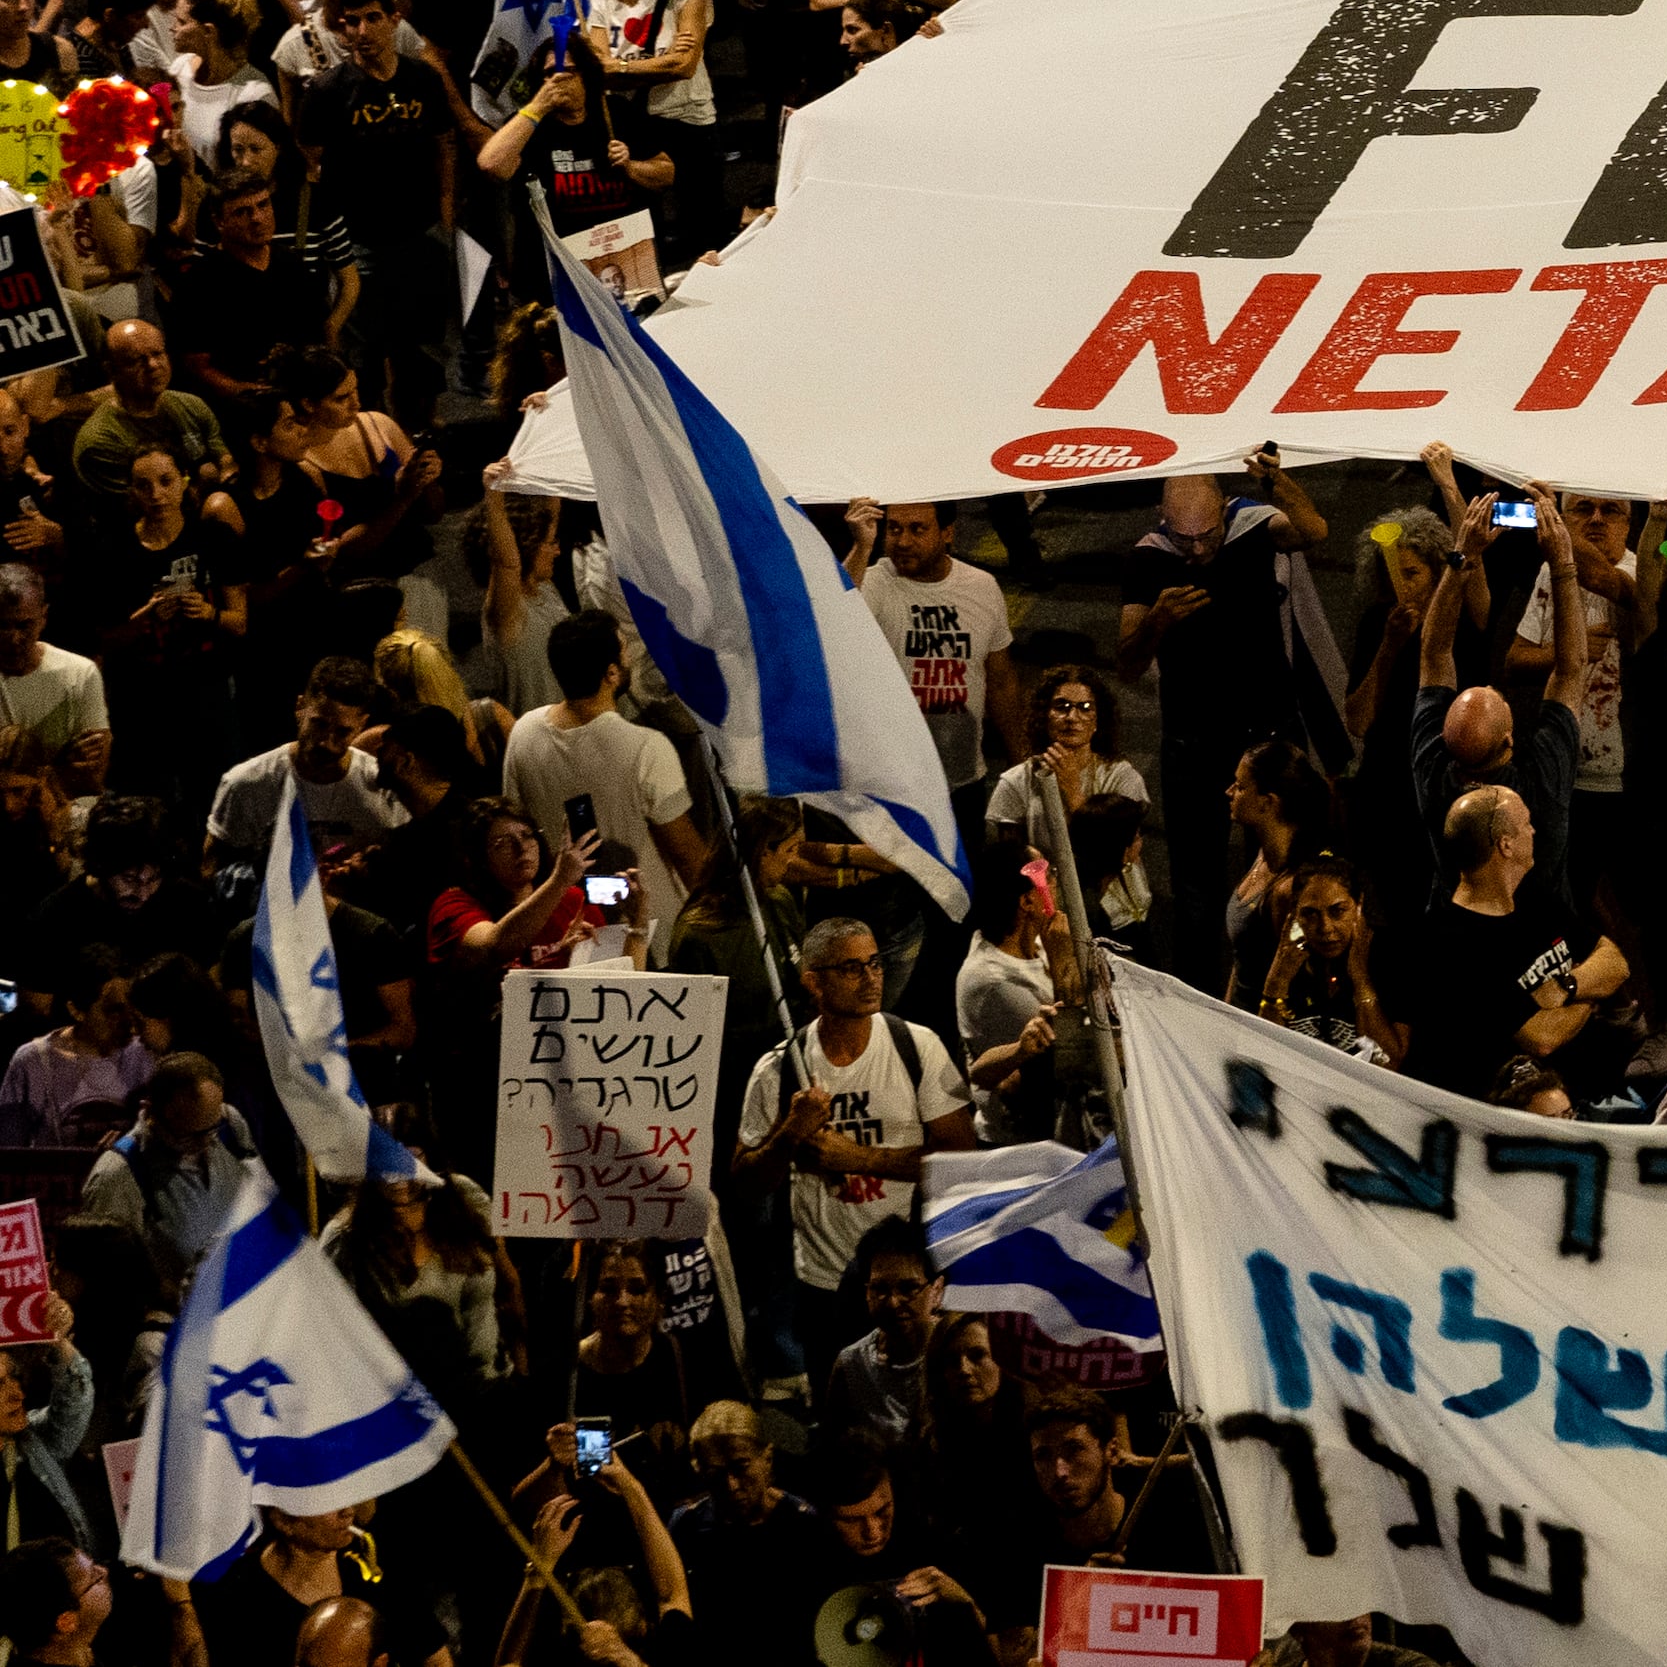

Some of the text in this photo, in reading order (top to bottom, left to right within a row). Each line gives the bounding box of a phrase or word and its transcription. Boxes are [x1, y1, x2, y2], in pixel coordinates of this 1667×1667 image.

[905, 631, 971, 660] הראש
[914, 659, 968, 688] אתה
[528, 982, 690, 1025] אתם
[529, 1023, 703, 1068] עושים
[501, 1074, 698, 1115] טרגדיה?
[538, 1121, 698, 1160] אנחנו
[552, 1162, 694, 1191] נעשה
[499, 1189, 688, 1229] דרמה!
[1218, 1407, 1584, 1626] שלך
[1109, 1602, 1200, 1638] חיים
